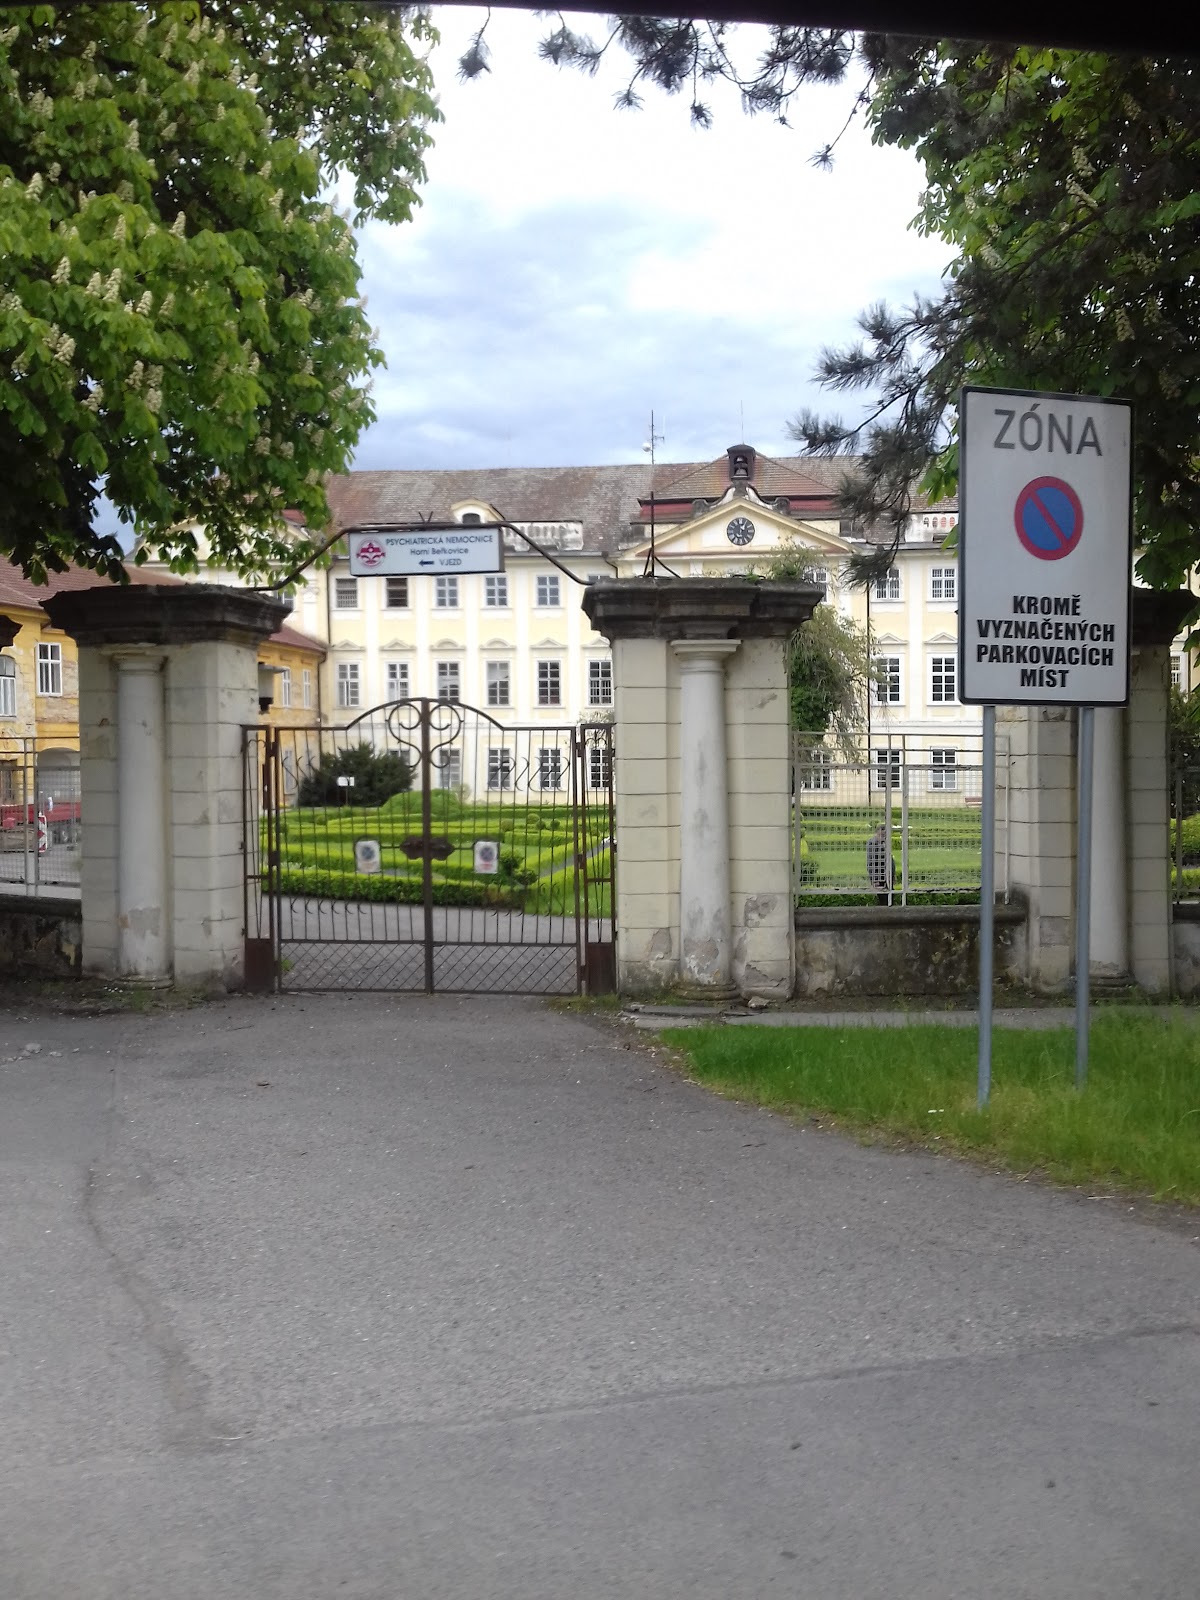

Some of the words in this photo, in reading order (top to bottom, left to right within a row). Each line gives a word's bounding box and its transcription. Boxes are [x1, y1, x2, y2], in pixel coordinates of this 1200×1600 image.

[994, 403, 1103, 456] ZÓNA
[386, 536, 443, 546] PSYCHIATRICKÁ
[446, 535, 493, 543] NEMOCNICE
[1012, 594, 1081, 616] KROMĚ
[976, 618, 1115, 642] VYZNAČENÝCH
[976, 644, 1114, 666] PARKOVACÍCH
[1020, 666, 1070, 688] MÍST
